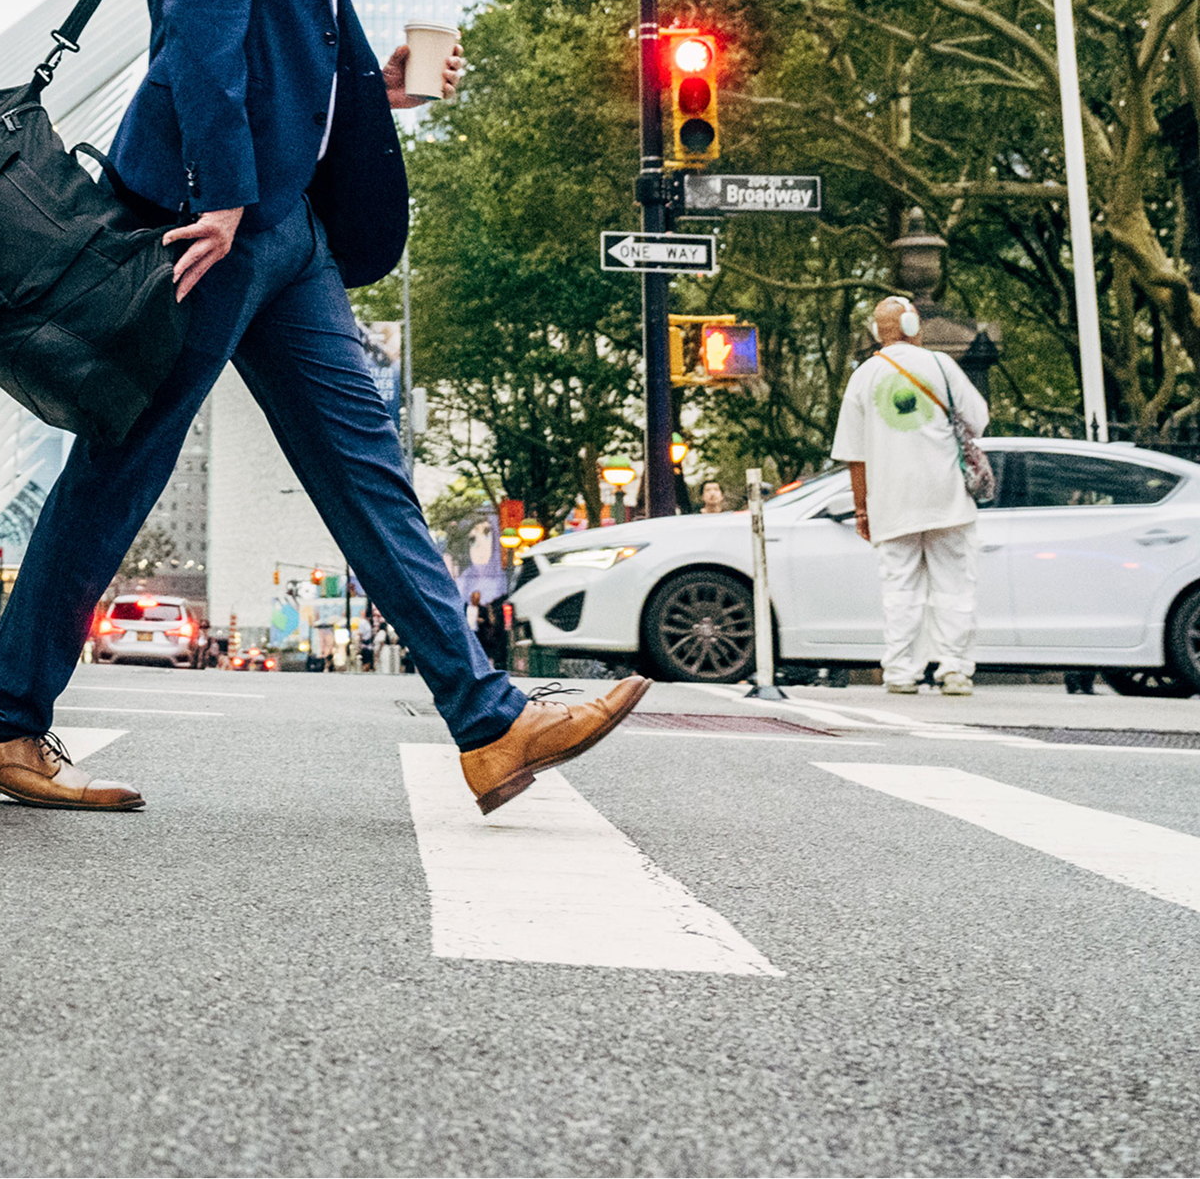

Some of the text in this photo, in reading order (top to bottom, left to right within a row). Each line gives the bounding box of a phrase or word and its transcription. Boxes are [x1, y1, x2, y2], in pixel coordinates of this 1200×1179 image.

[726, 184, 813, 208] Broadway
[620, 244, 698, 260] ONE WAY
